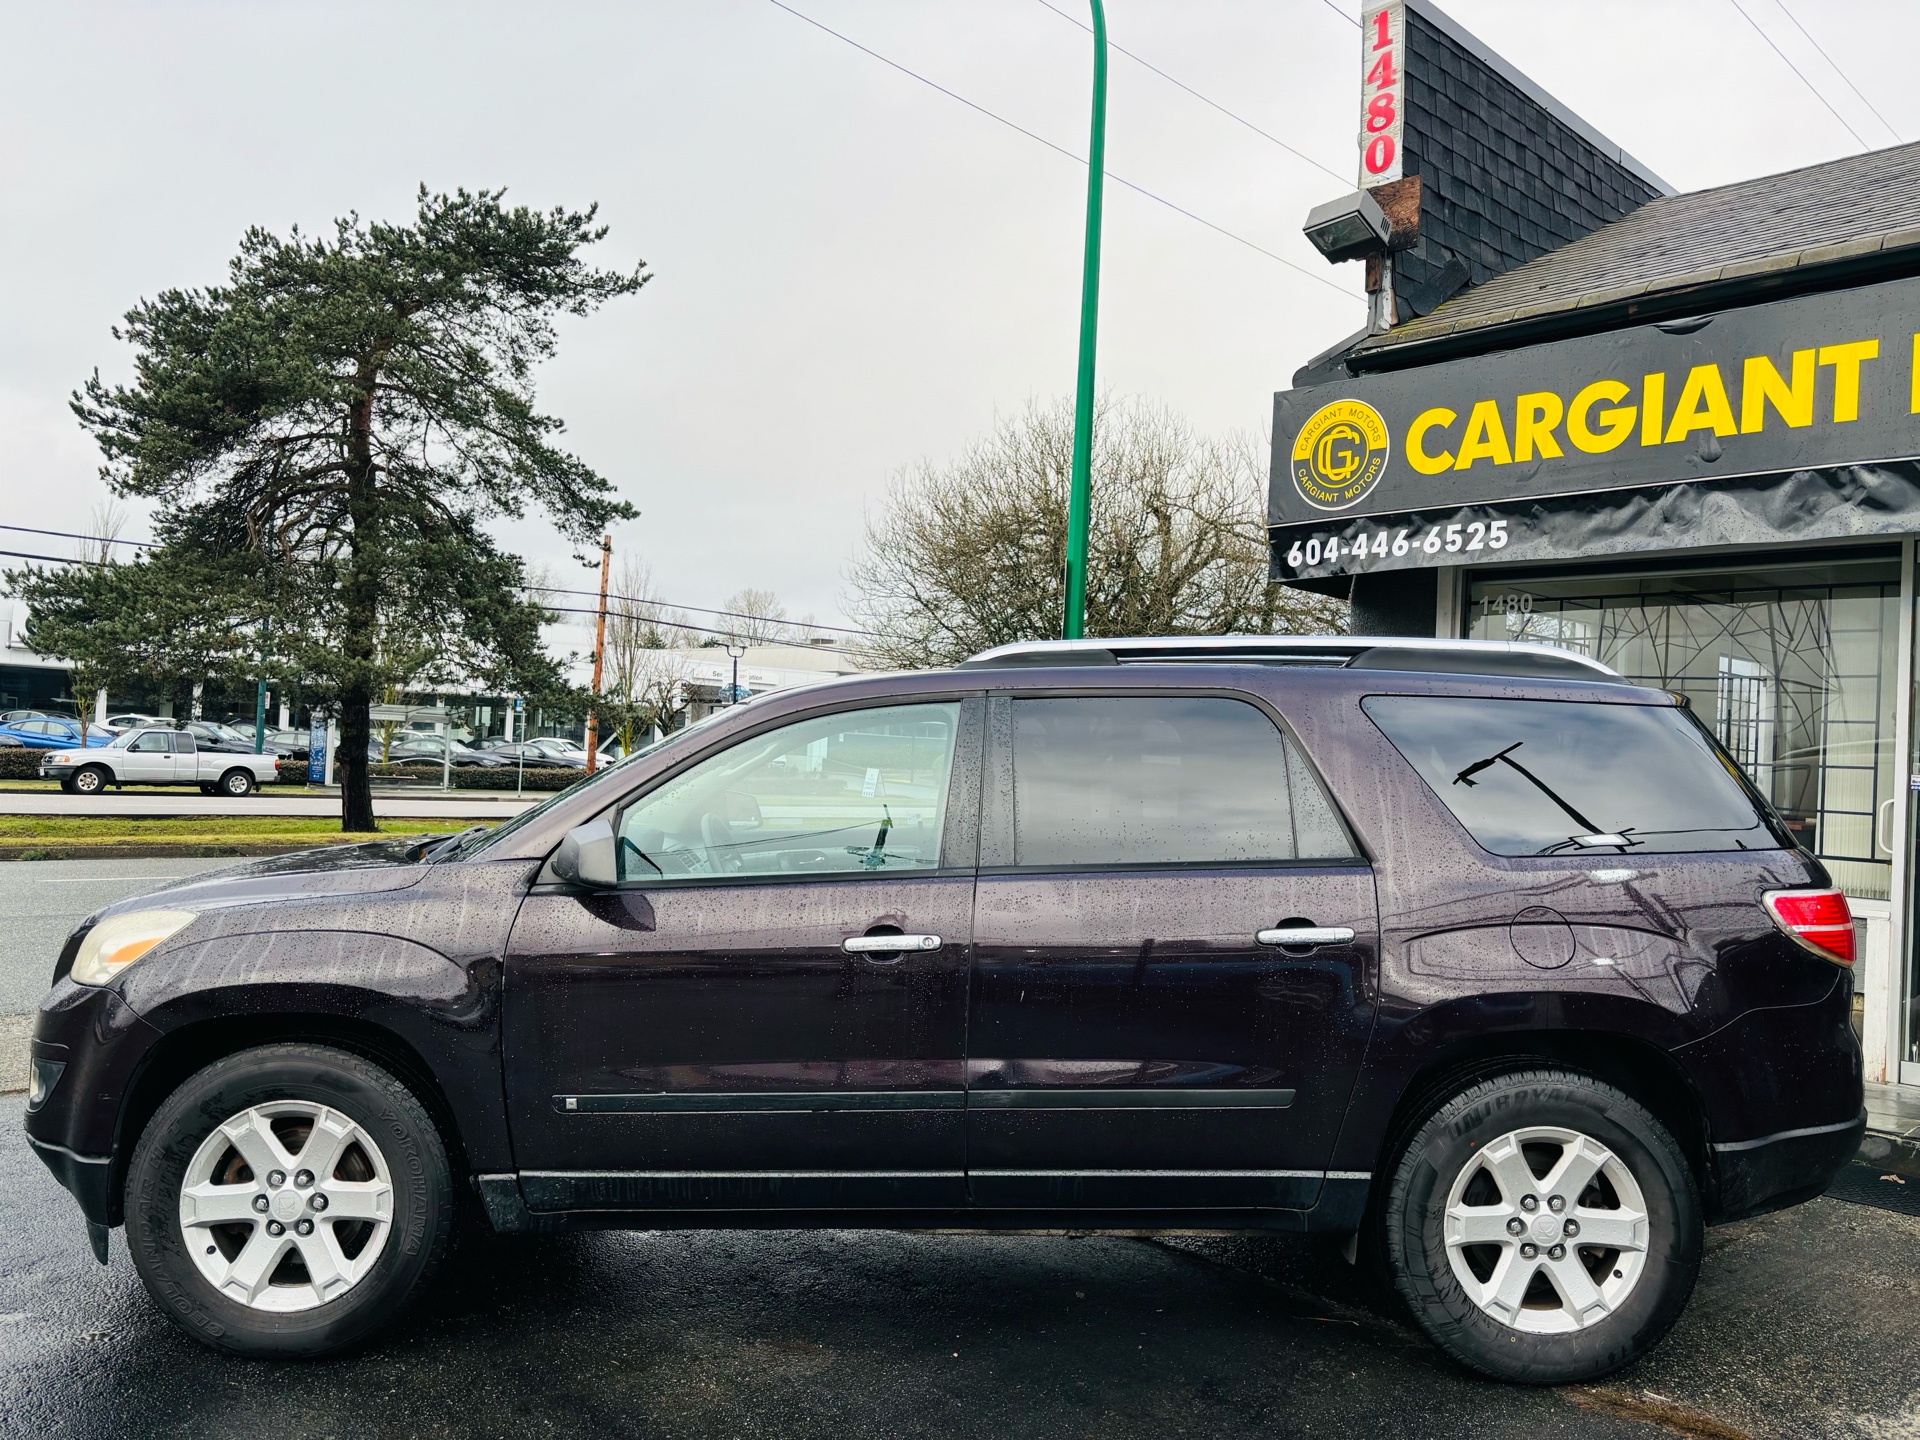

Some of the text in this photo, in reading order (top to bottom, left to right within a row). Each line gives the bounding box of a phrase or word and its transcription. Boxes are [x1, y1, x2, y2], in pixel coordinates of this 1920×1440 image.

[1365, 10, 1397, 174] 1480
[1300, 408, 1381, 451] CARGIANT MOTORS
[1405, 339, 1880, 476] CARGIANT
[1299, 457, 1381, 502] CARGIANT MOTORS
[1287, 520, 1509, 568] 604-446-6525
[1479, 593, 1533, 614] 1480
[378, 1106, 427, 1256] YOKOHAMA
[139, 1178, 225, 1338] GEOLANDAR
